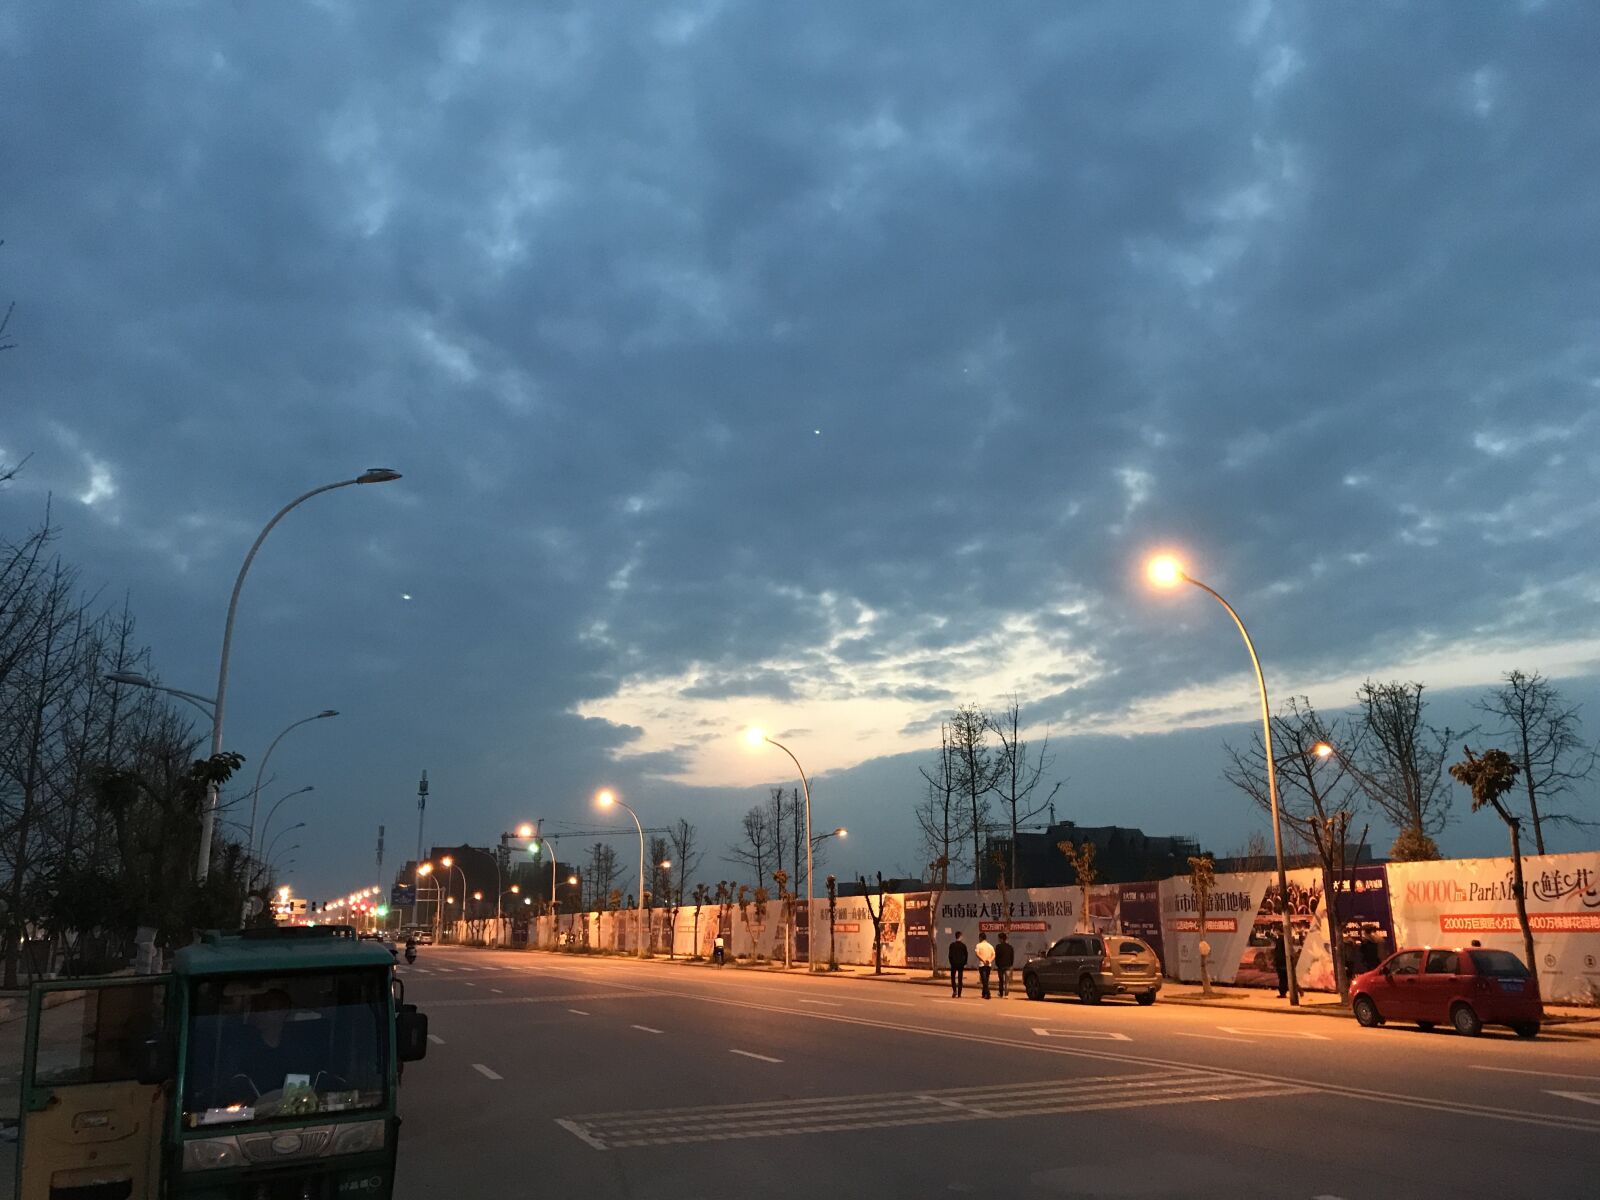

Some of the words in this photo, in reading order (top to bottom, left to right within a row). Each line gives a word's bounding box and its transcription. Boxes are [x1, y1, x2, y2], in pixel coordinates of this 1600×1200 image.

[1469, 878, 1528, 902] ParkMl
[1164, 892, 1251, 912] 市旅游新地标
